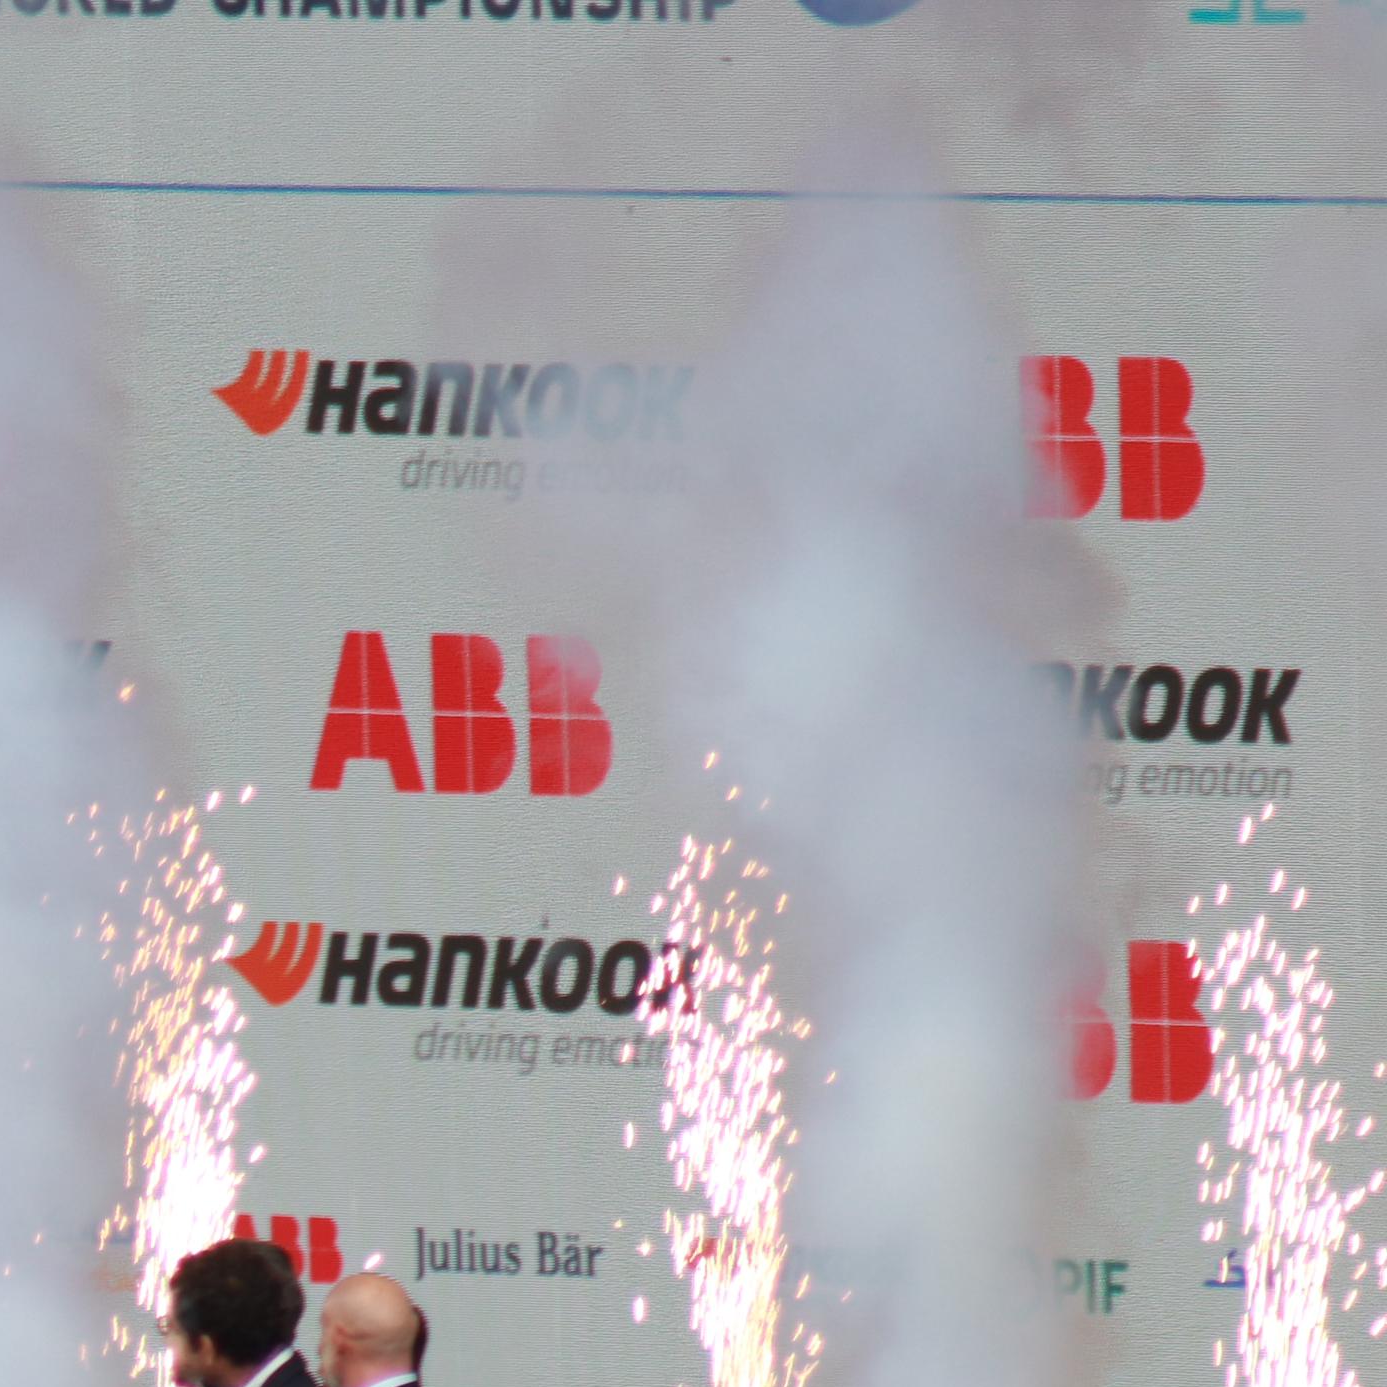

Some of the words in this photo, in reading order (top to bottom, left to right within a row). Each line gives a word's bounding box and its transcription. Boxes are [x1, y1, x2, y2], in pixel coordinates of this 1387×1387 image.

[1019, 355, 1206, 521] BB
[309, 630, 613, 797] ABB
[1139, 757, 1294, 799] emotion
[414, 1018, 542, 1073] driving
[416, 1226, 522, 1281] Julius
[537, 1230, 603, 1278] Bär
